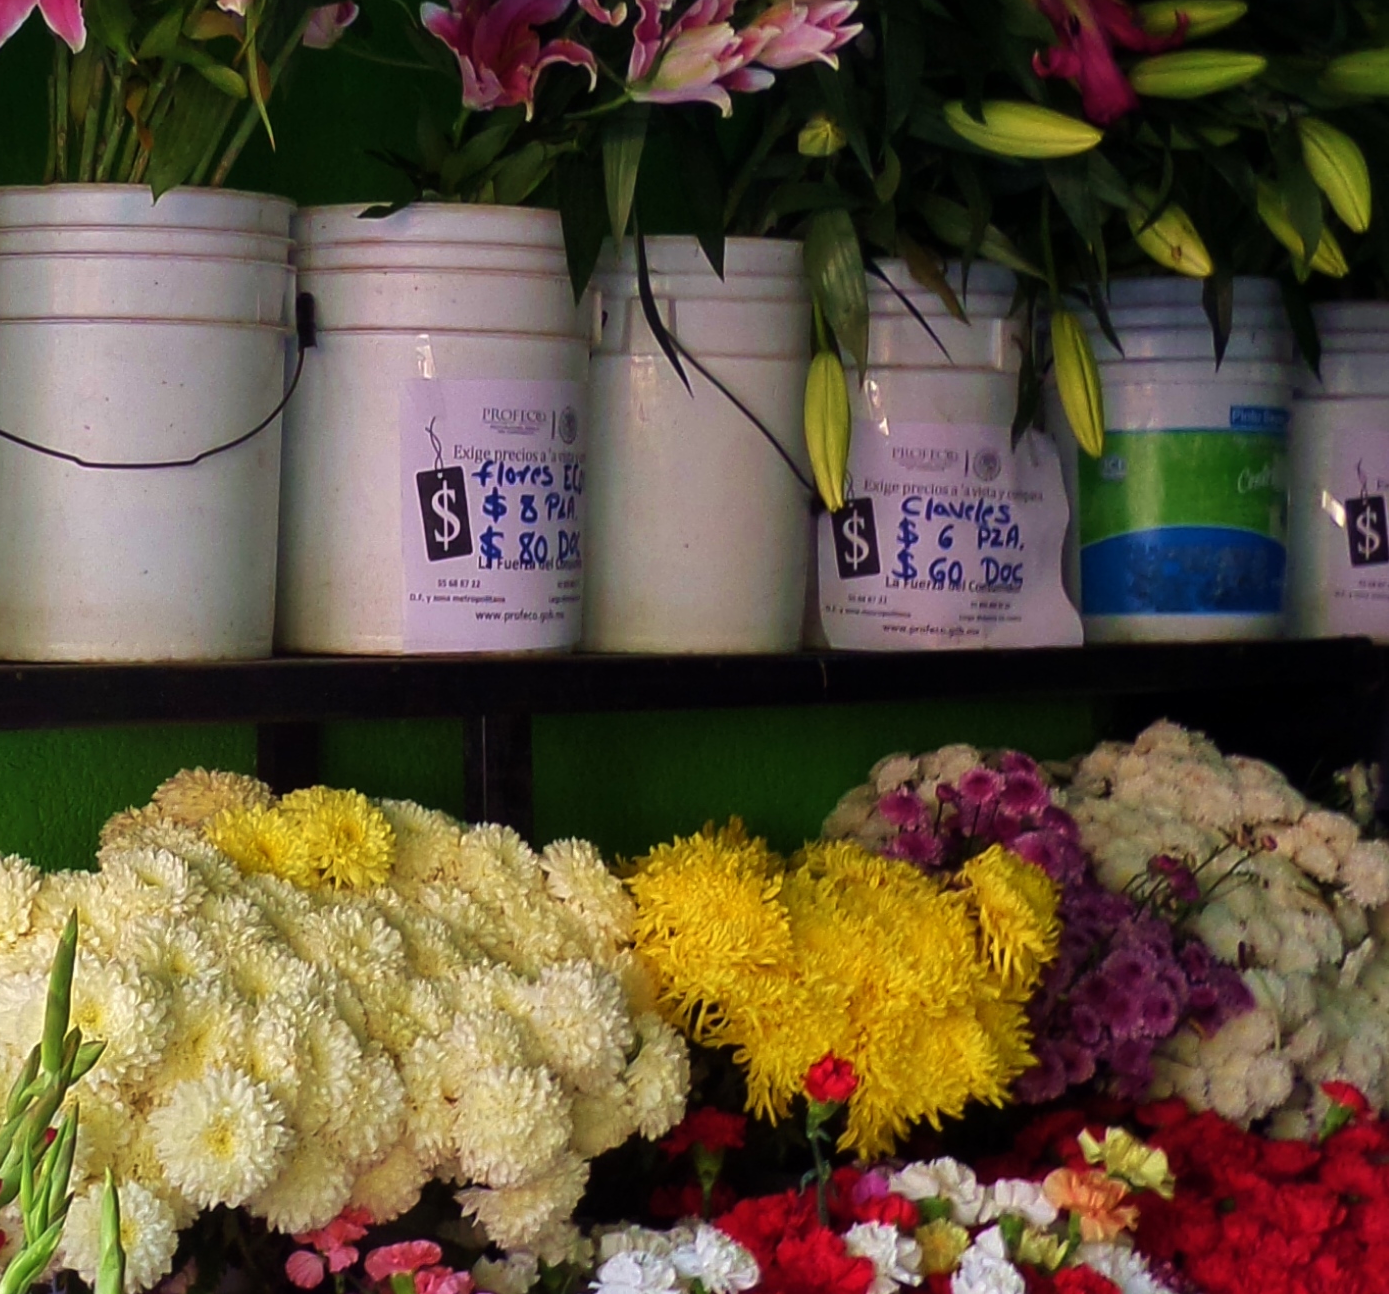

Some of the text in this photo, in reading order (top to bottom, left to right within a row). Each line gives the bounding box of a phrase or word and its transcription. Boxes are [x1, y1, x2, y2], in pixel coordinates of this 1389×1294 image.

[454, 444, 491, 464] Exige
[494, 448, 539, 463] precios
[482, 486, 507, 524] $
[901, 495, 1011, 527] Claveles
[479, 525, 504, 569] $
[519, 531, 548, 565] 80
[897, 517, 919, 549] $
[938, 524, 954, 549] 6
[892, 548, 918, 582] $
